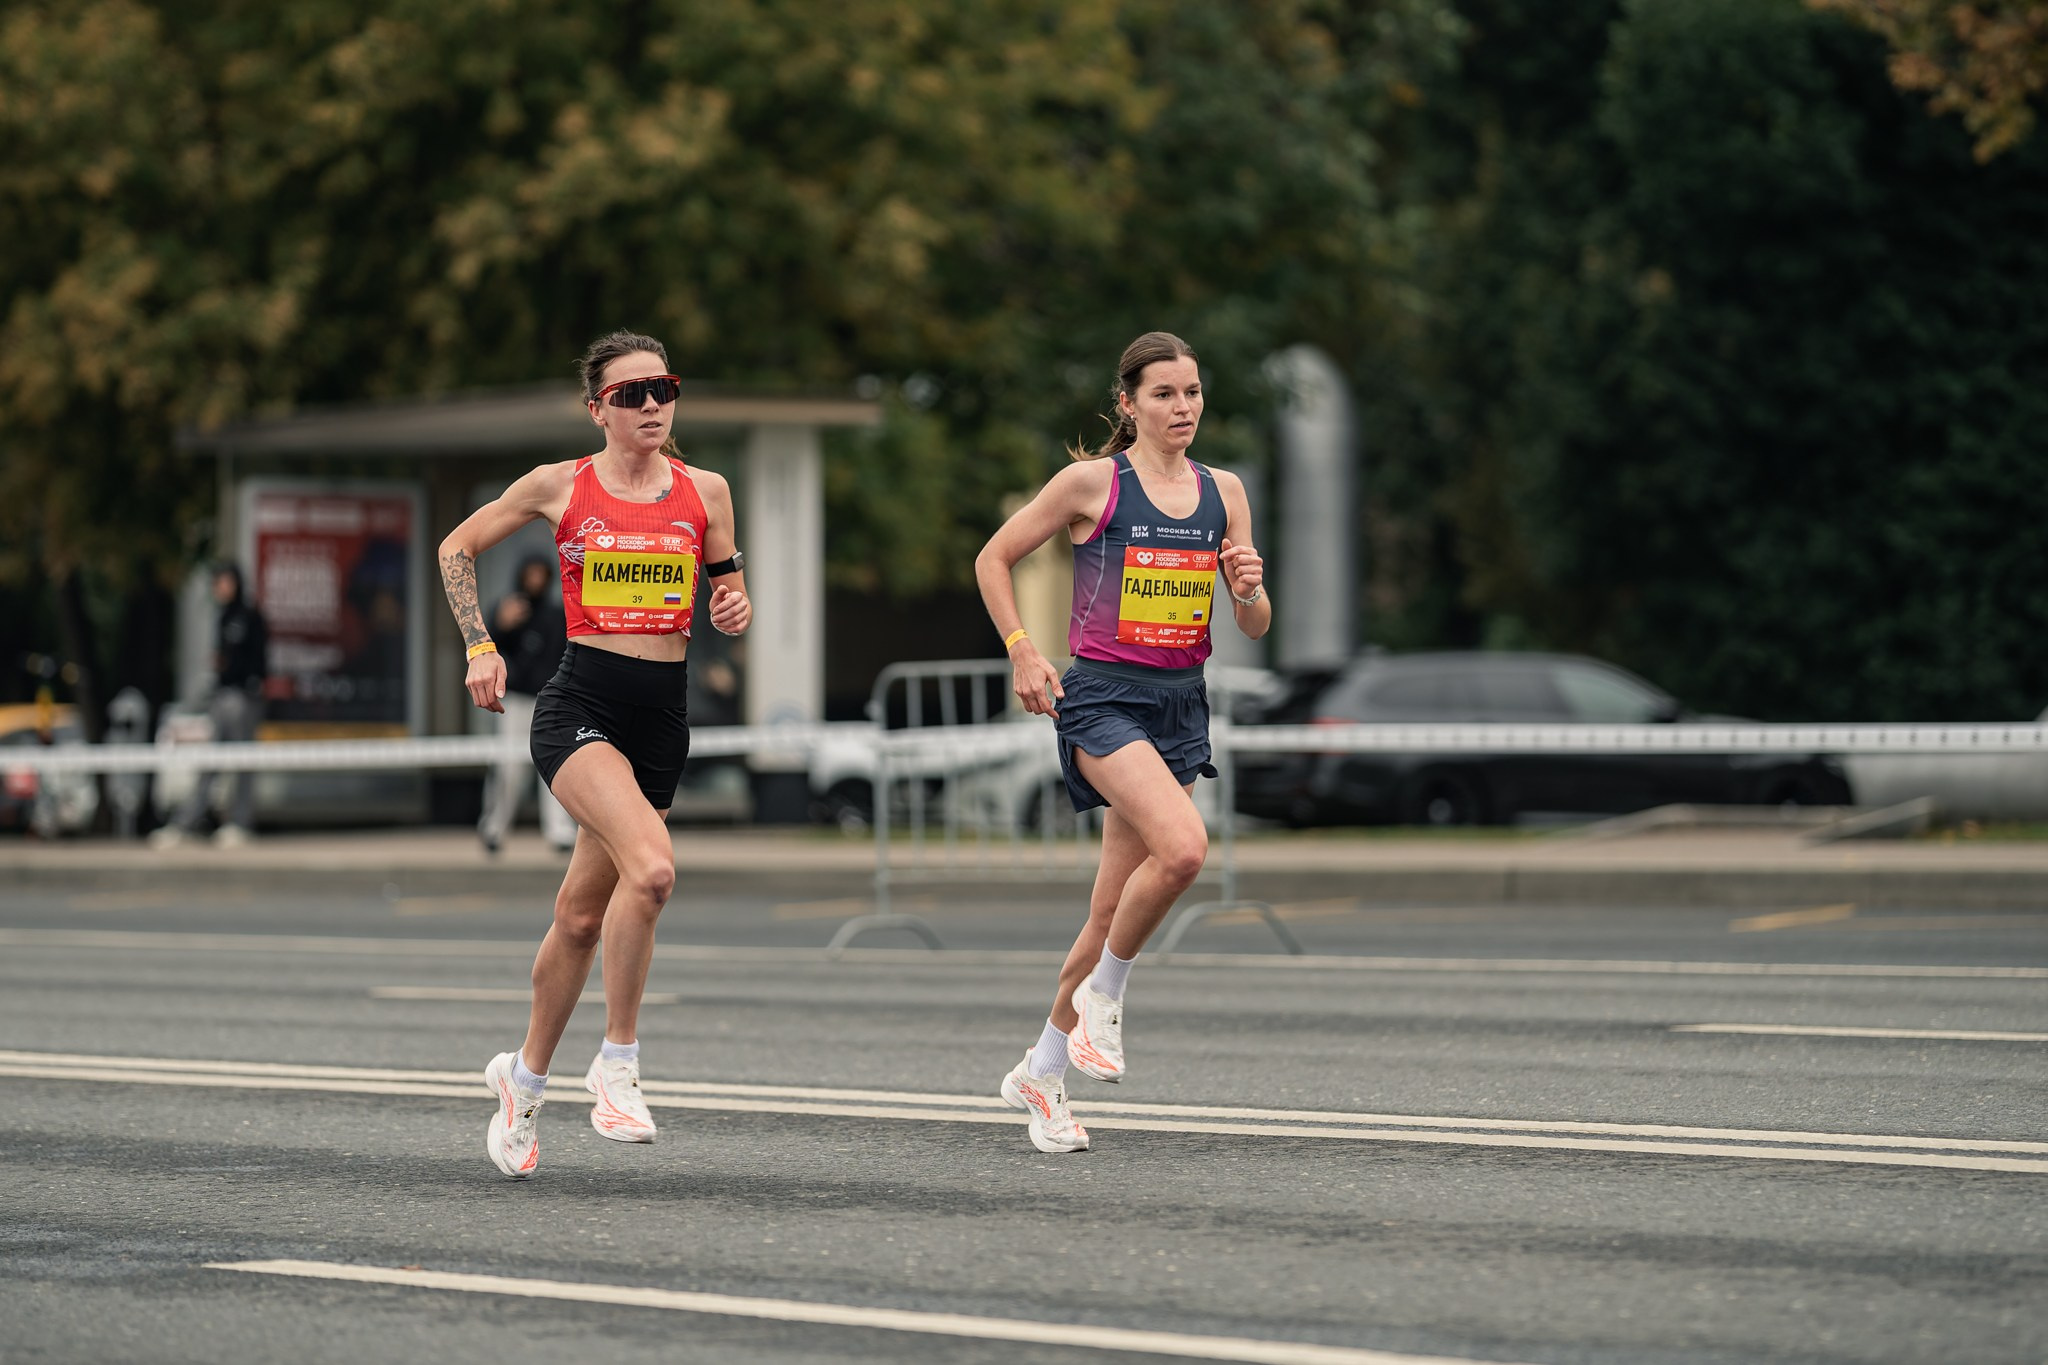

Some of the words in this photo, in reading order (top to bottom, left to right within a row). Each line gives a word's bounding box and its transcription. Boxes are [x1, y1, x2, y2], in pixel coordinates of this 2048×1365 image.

[592, 562, 684, 584] КАМЕНЕВА
[1124, 577, 1211, 598] ГАДЕЛЬШИНА
[632, 595, 643, 604] 39
[1167, 612, 1177, 620] 35
